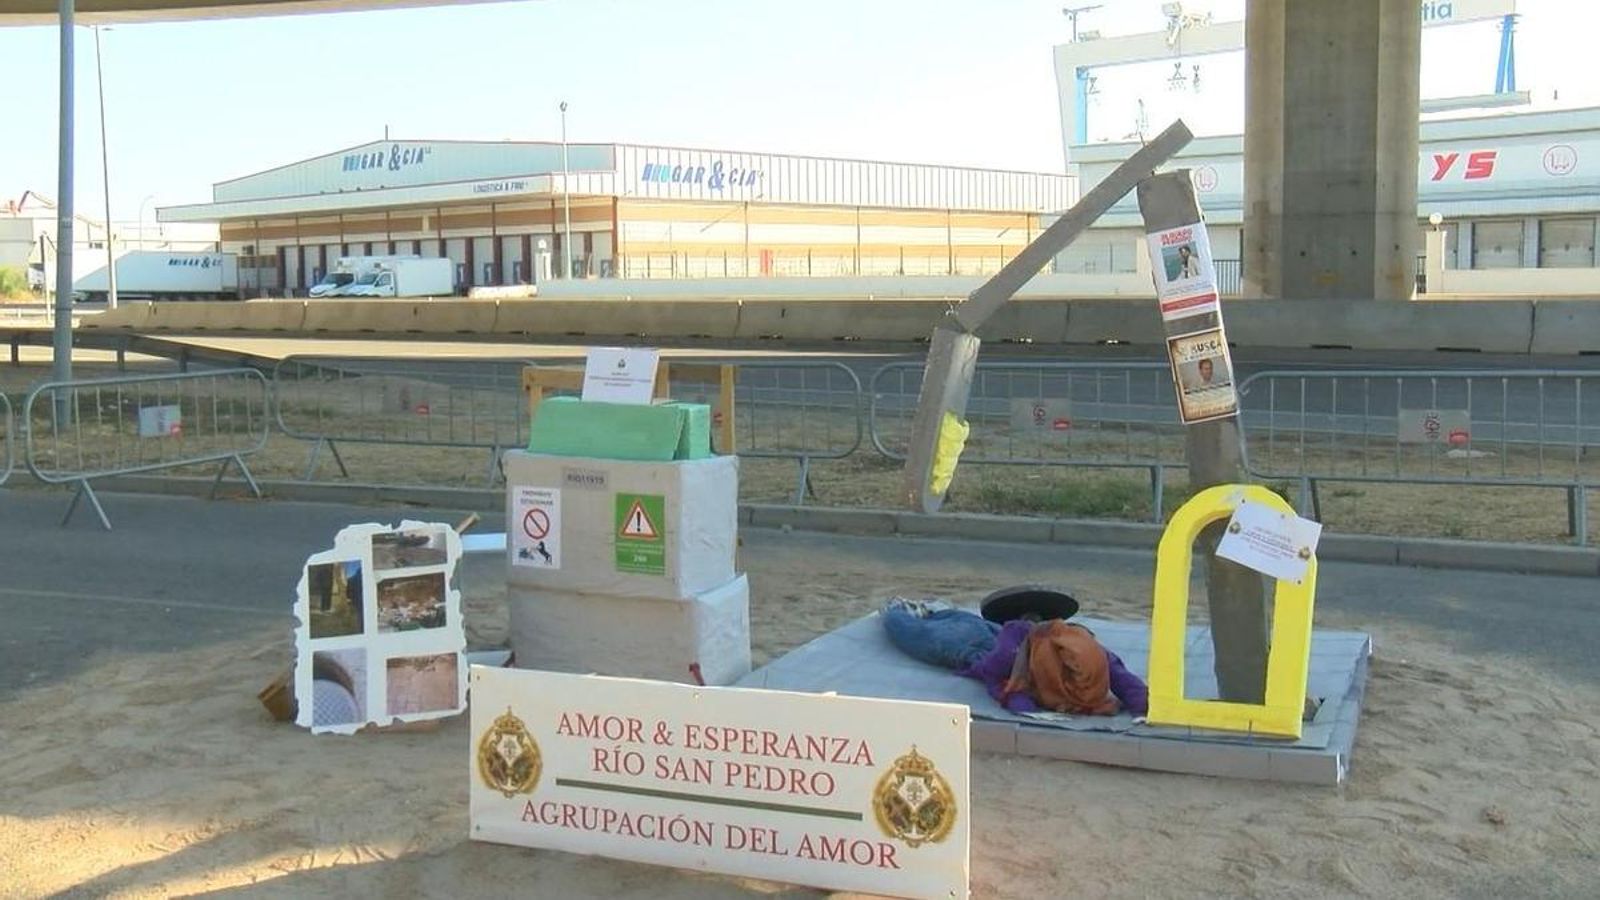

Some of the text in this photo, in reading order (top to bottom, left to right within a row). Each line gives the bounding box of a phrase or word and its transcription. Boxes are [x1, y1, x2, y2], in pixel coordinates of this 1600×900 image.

[388, 143, 401, 171] &
[708, 160, 725, 191] &
[555, 712, 876, 767] AMOR & ESPERANZA
[592, 747, 836, 797] RÍO SAN PEDRO
[520, 799, 901, 870] AGRUPACIÓN DEL AMOR
